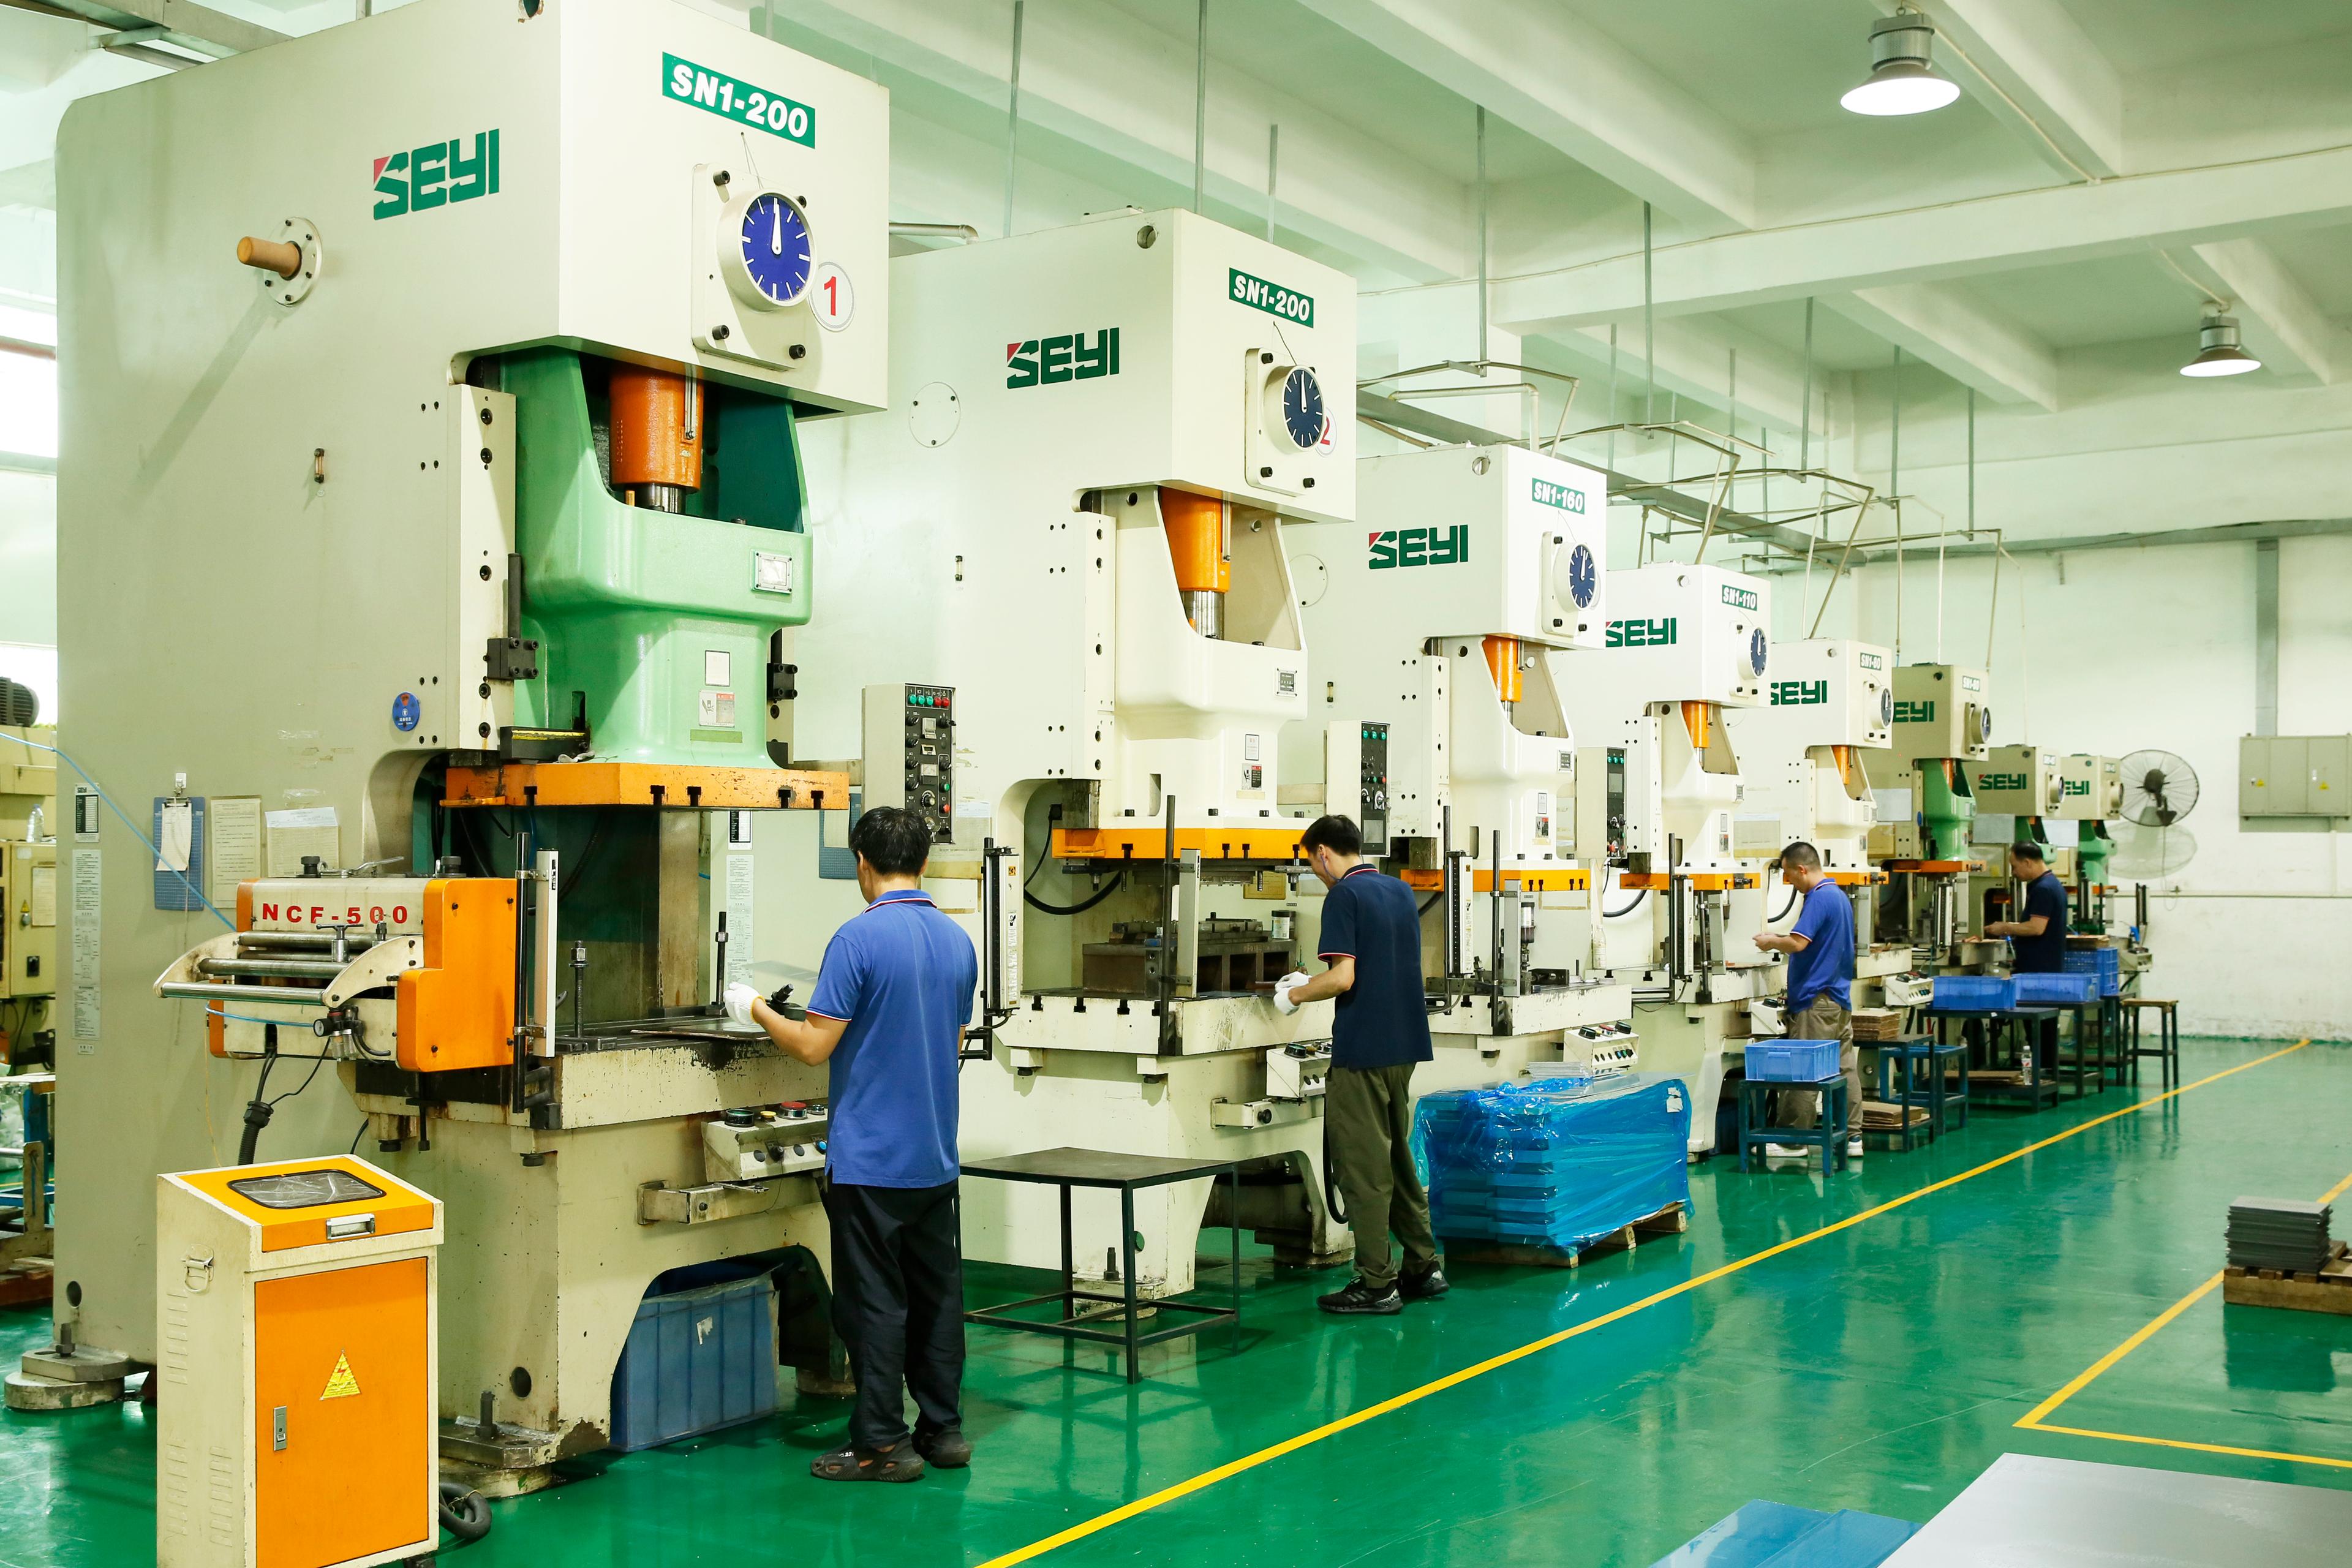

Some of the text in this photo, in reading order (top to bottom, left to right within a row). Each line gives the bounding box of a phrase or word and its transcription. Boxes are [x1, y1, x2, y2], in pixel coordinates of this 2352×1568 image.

[671, 64, 808, 138] SN1-200
[373, 128, 500, 221] SEYI
[824, 276, 837, 316] 1
[1233, 274, 1310, 323] SN1-200
[1007, 328, 1120, 389] SEYI
[1320, 416, 1330, 445] 2
[1534, 481, 1583, 512] SN1-160
[1368, 524, 1468, 570] SEYI
[1723, 587, 1756, 609] SN1-110
[1605, 617, 1676, 647] SEYI
[1979, 774, 2027, 790] SEYI
[262, 903, 408, 924] NCF-500
